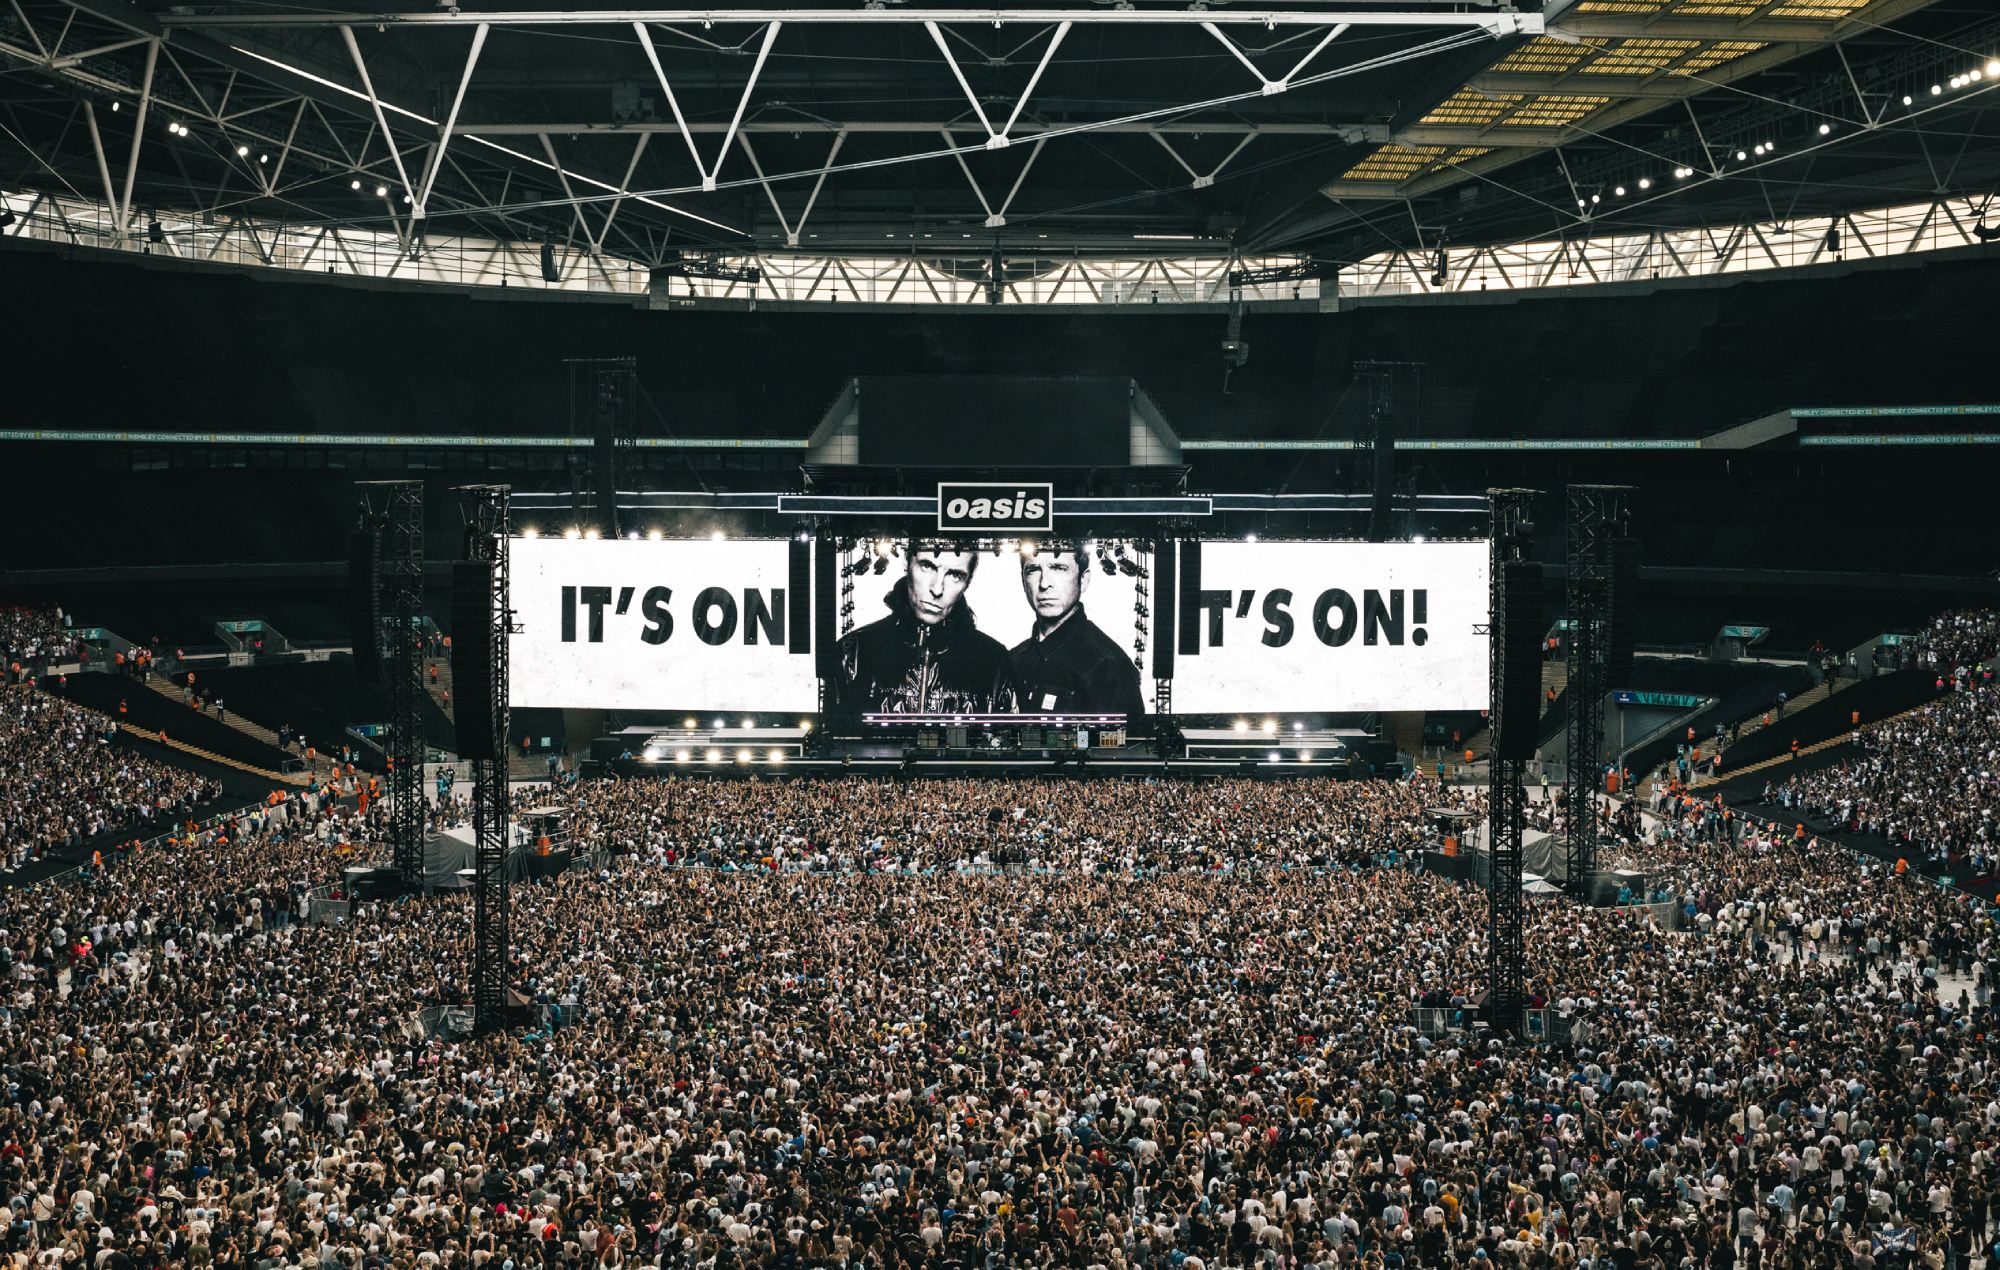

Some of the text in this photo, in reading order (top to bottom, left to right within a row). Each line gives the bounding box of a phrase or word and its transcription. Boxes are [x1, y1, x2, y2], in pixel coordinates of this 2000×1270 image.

[947, 491, 1045, 519] oasis
[561, 585, 674, 645] IT'S
[1200, 588, 1428, 648] T'S ON!
